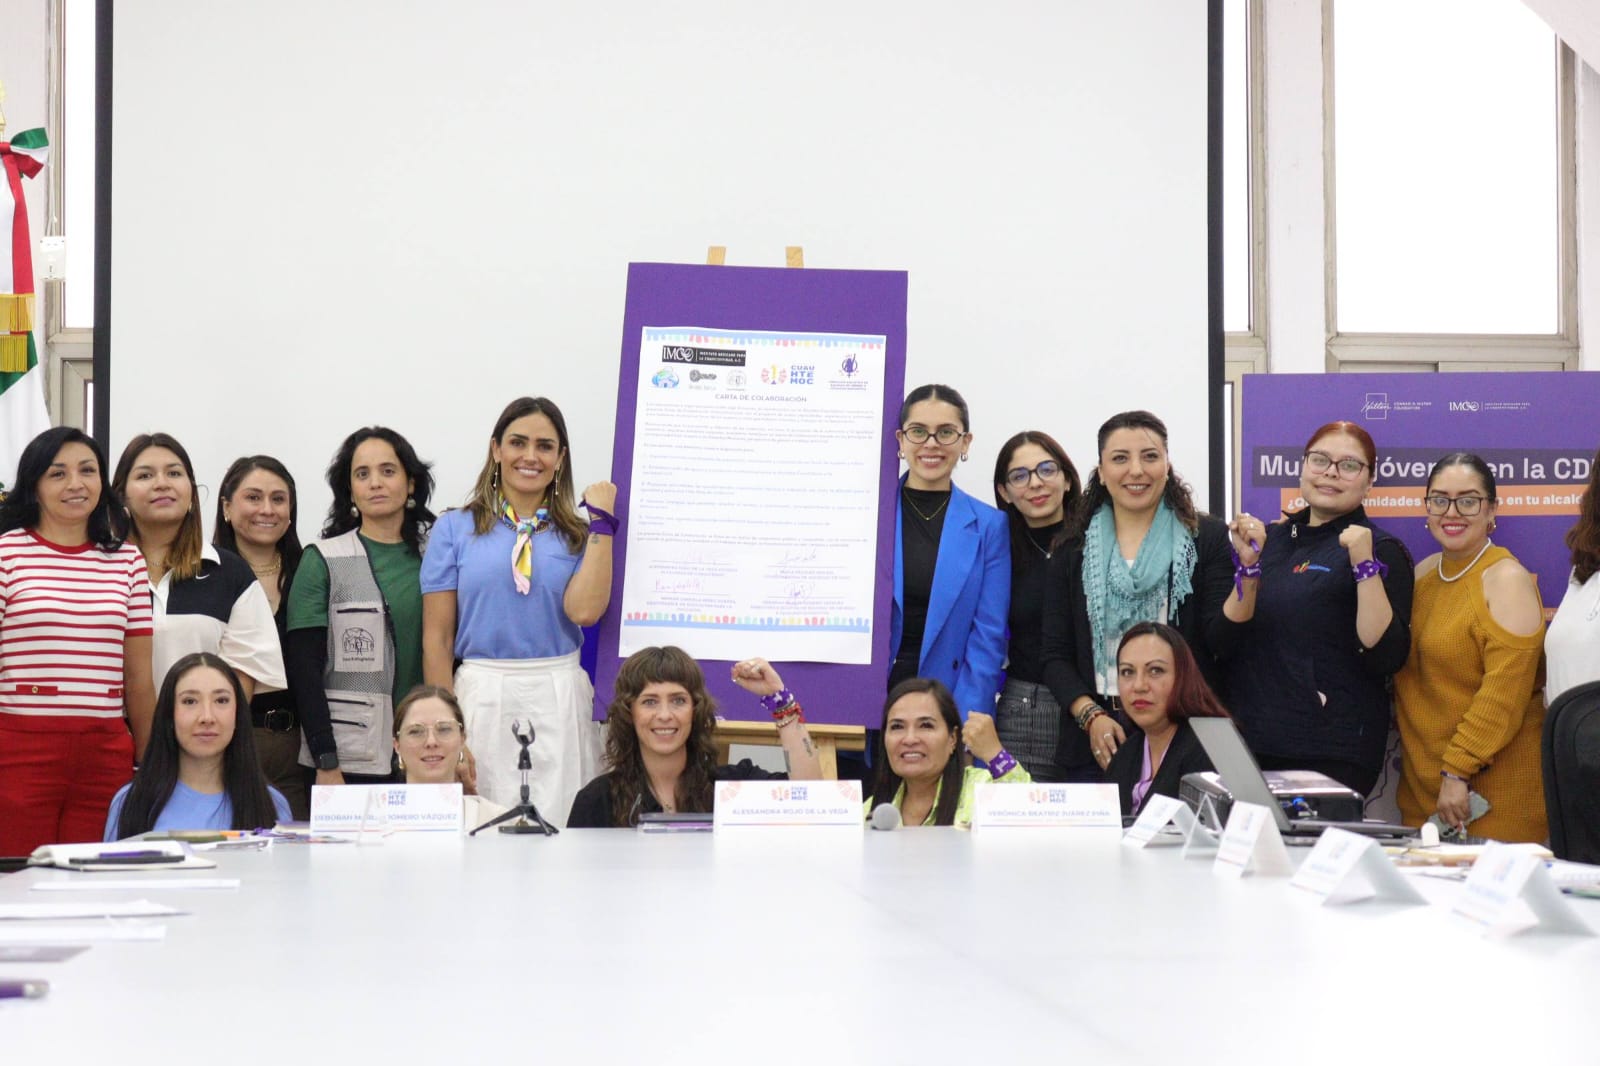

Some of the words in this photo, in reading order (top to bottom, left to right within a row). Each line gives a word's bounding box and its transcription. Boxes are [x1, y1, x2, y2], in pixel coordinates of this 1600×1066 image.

[751, 394, 807, 402] COLABORACIÓN
[1373, 456, 1437, 482] jóve
[1523, 457, 1546, 479] la
[1554, 457, 1595, 480] CD
[1361, 495, 1421, 507] unidades
[1506, 496, 1522, 505] en
[1526, 494, 1540, 505] tu
